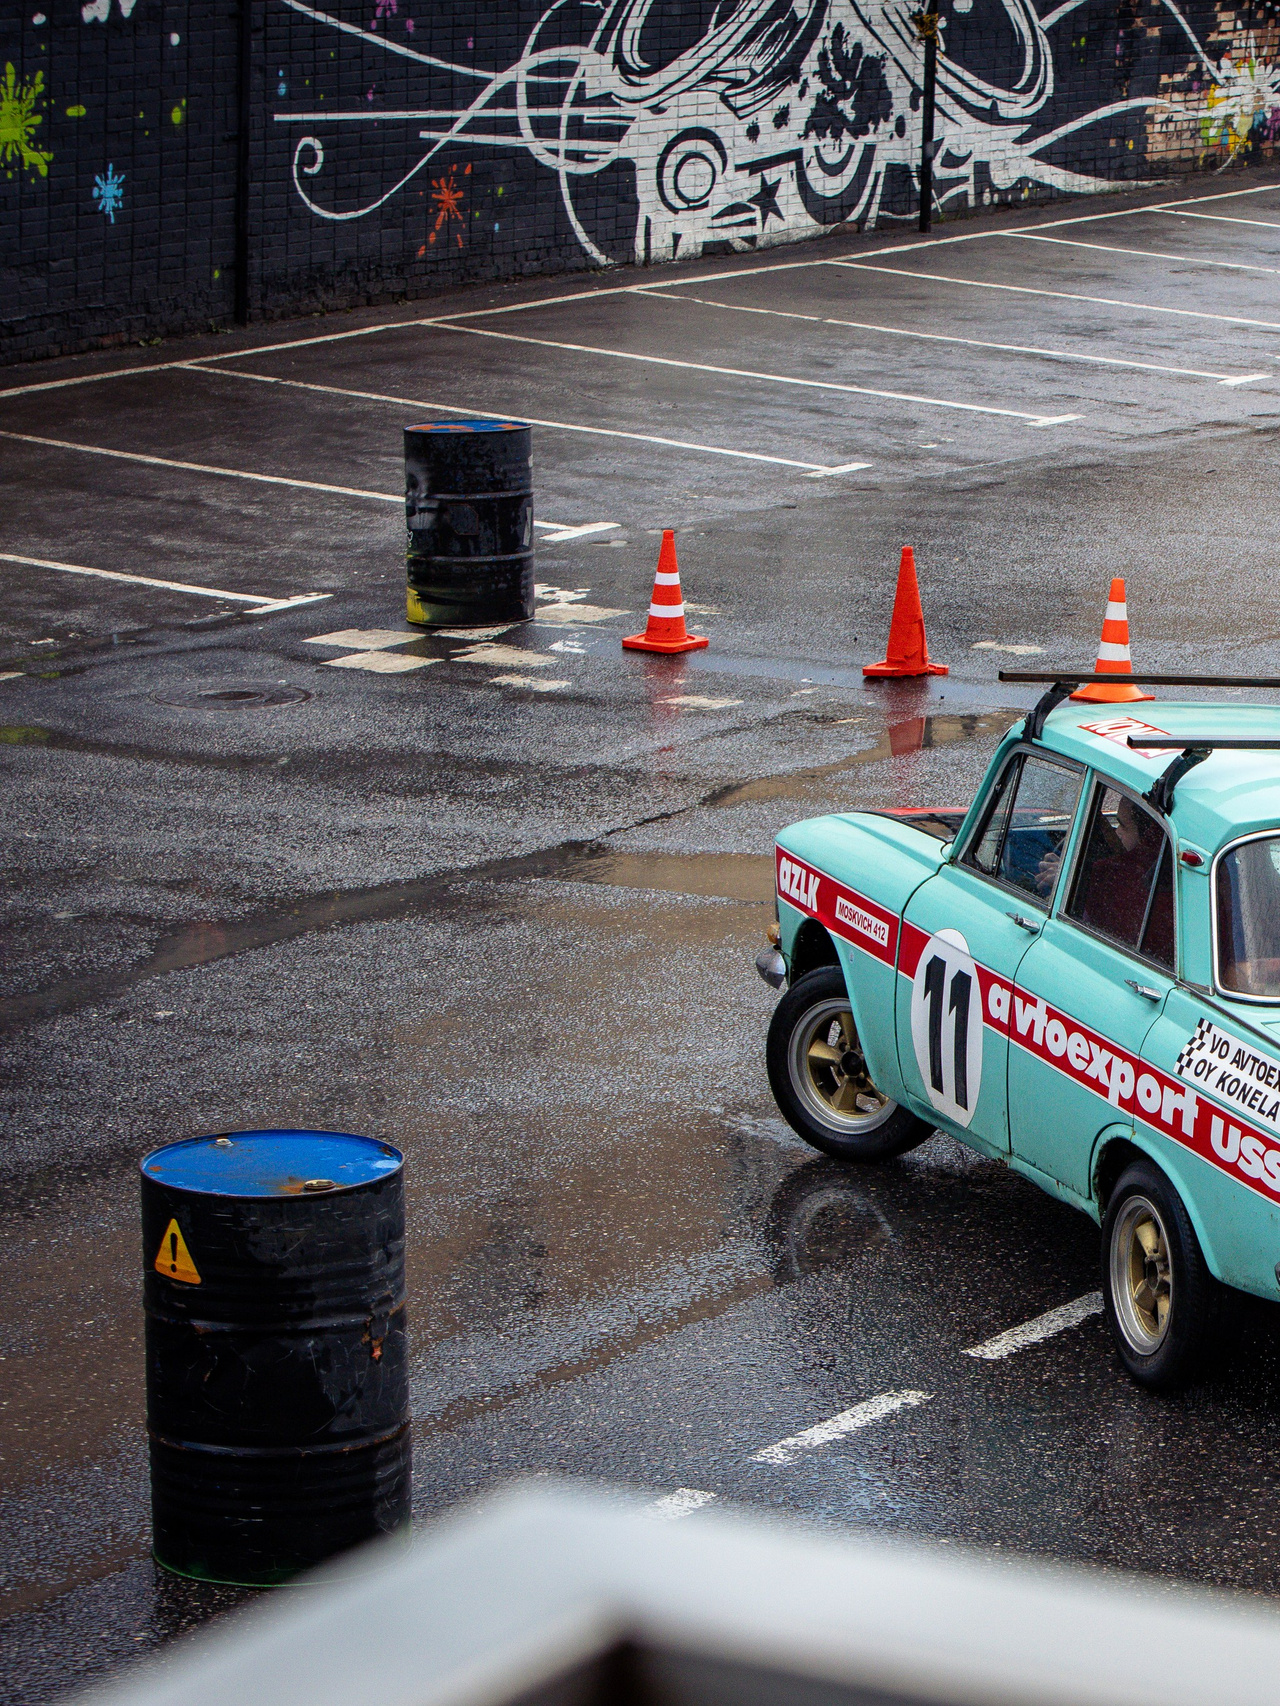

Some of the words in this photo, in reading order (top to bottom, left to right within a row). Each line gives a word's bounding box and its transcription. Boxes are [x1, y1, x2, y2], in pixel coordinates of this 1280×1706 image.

[838, 901, 873, 934] MOSKVICH
[873, 923, 886, 942] 412
[923, 954, 973, 1111] 11
[1209, 1033, 1230, 1060] VO
[1193, 1058, 1218, 1082] OY
[1215, 1070, 1280, 1122] KONELA
